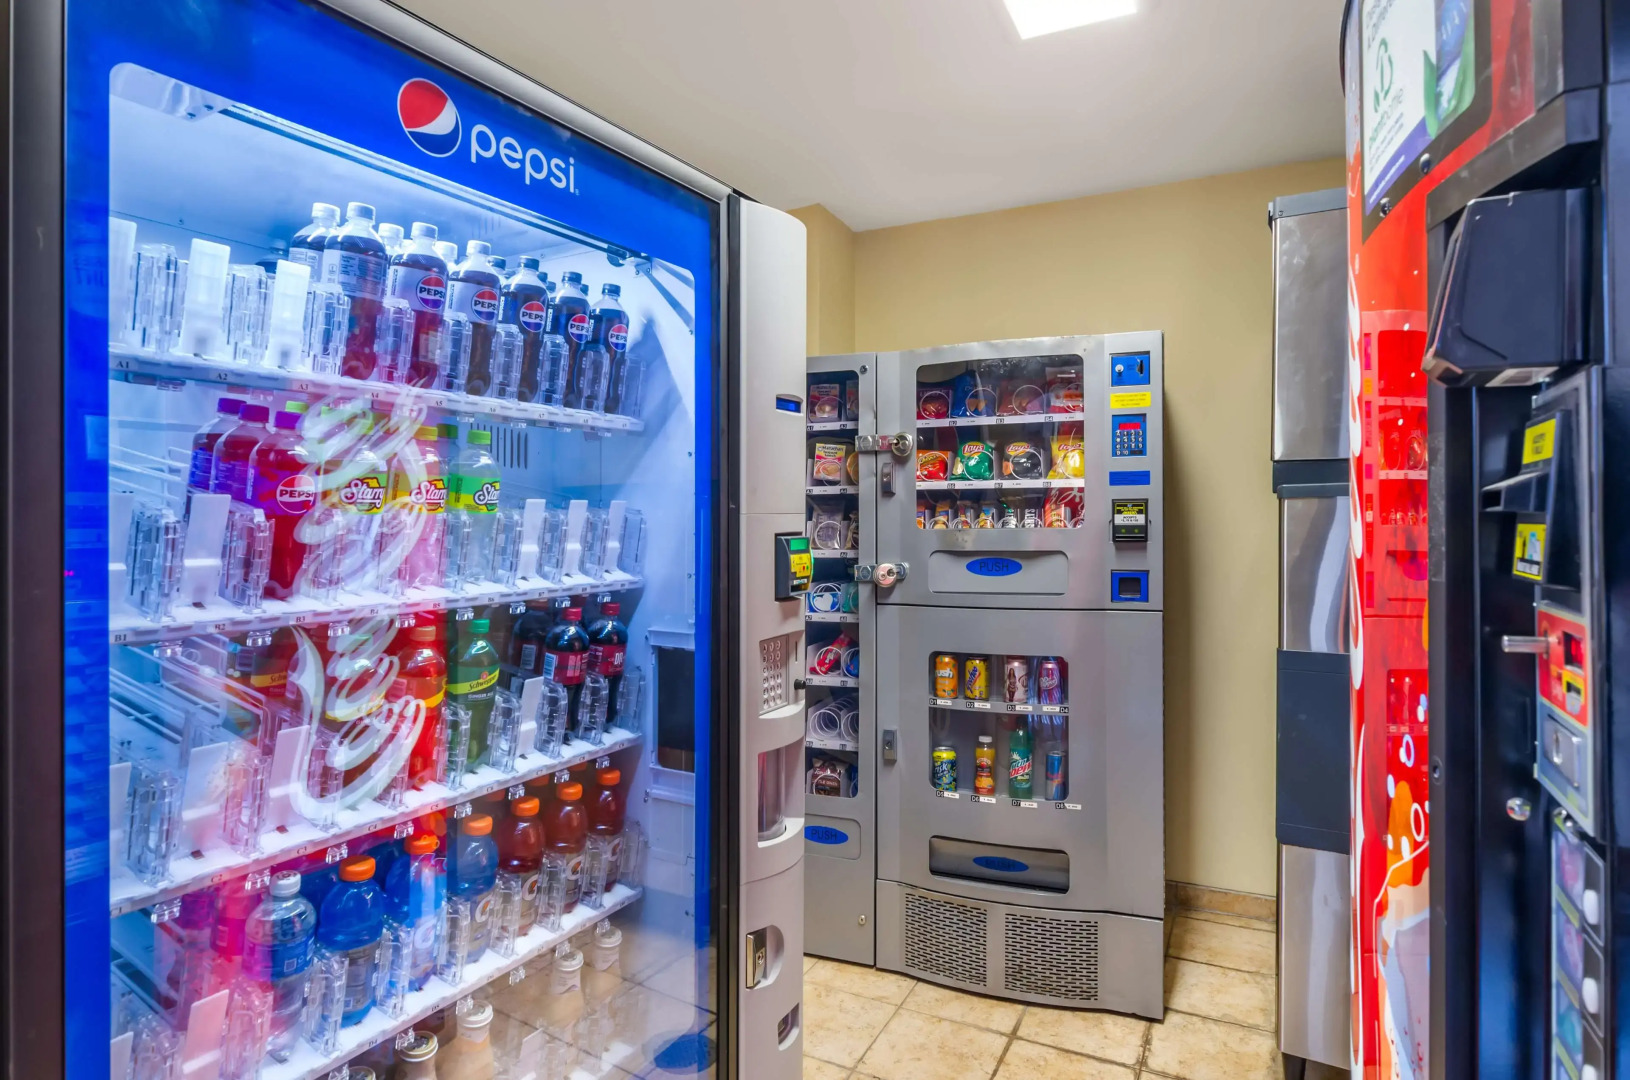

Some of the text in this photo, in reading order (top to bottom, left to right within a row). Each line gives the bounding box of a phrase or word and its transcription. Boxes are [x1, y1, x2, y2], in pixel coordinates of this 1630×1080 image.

[470, 123, 575, 194] pepsi
[474, 299, 498, 311] PEPS
[521, 311, 544, 322] PEPS
[569, 323, 590, 334] PEPS
[610, 333, 627, 343] PEPS
[116, 359, 130, 369] A1
[216, 372, 229, 382] A2
[298, 383, 309, 391] A3
[279, 489, 314, 498] PEPSI
[979, 561, 1009, 573] PUSH
[215, 623, 226, 631] B2
[114, 633, 127, 642] B1
[934, 763, 948, 775] risk
[810, 828, 837, 841] PUSH
[211, 874, 223, 883] C2
